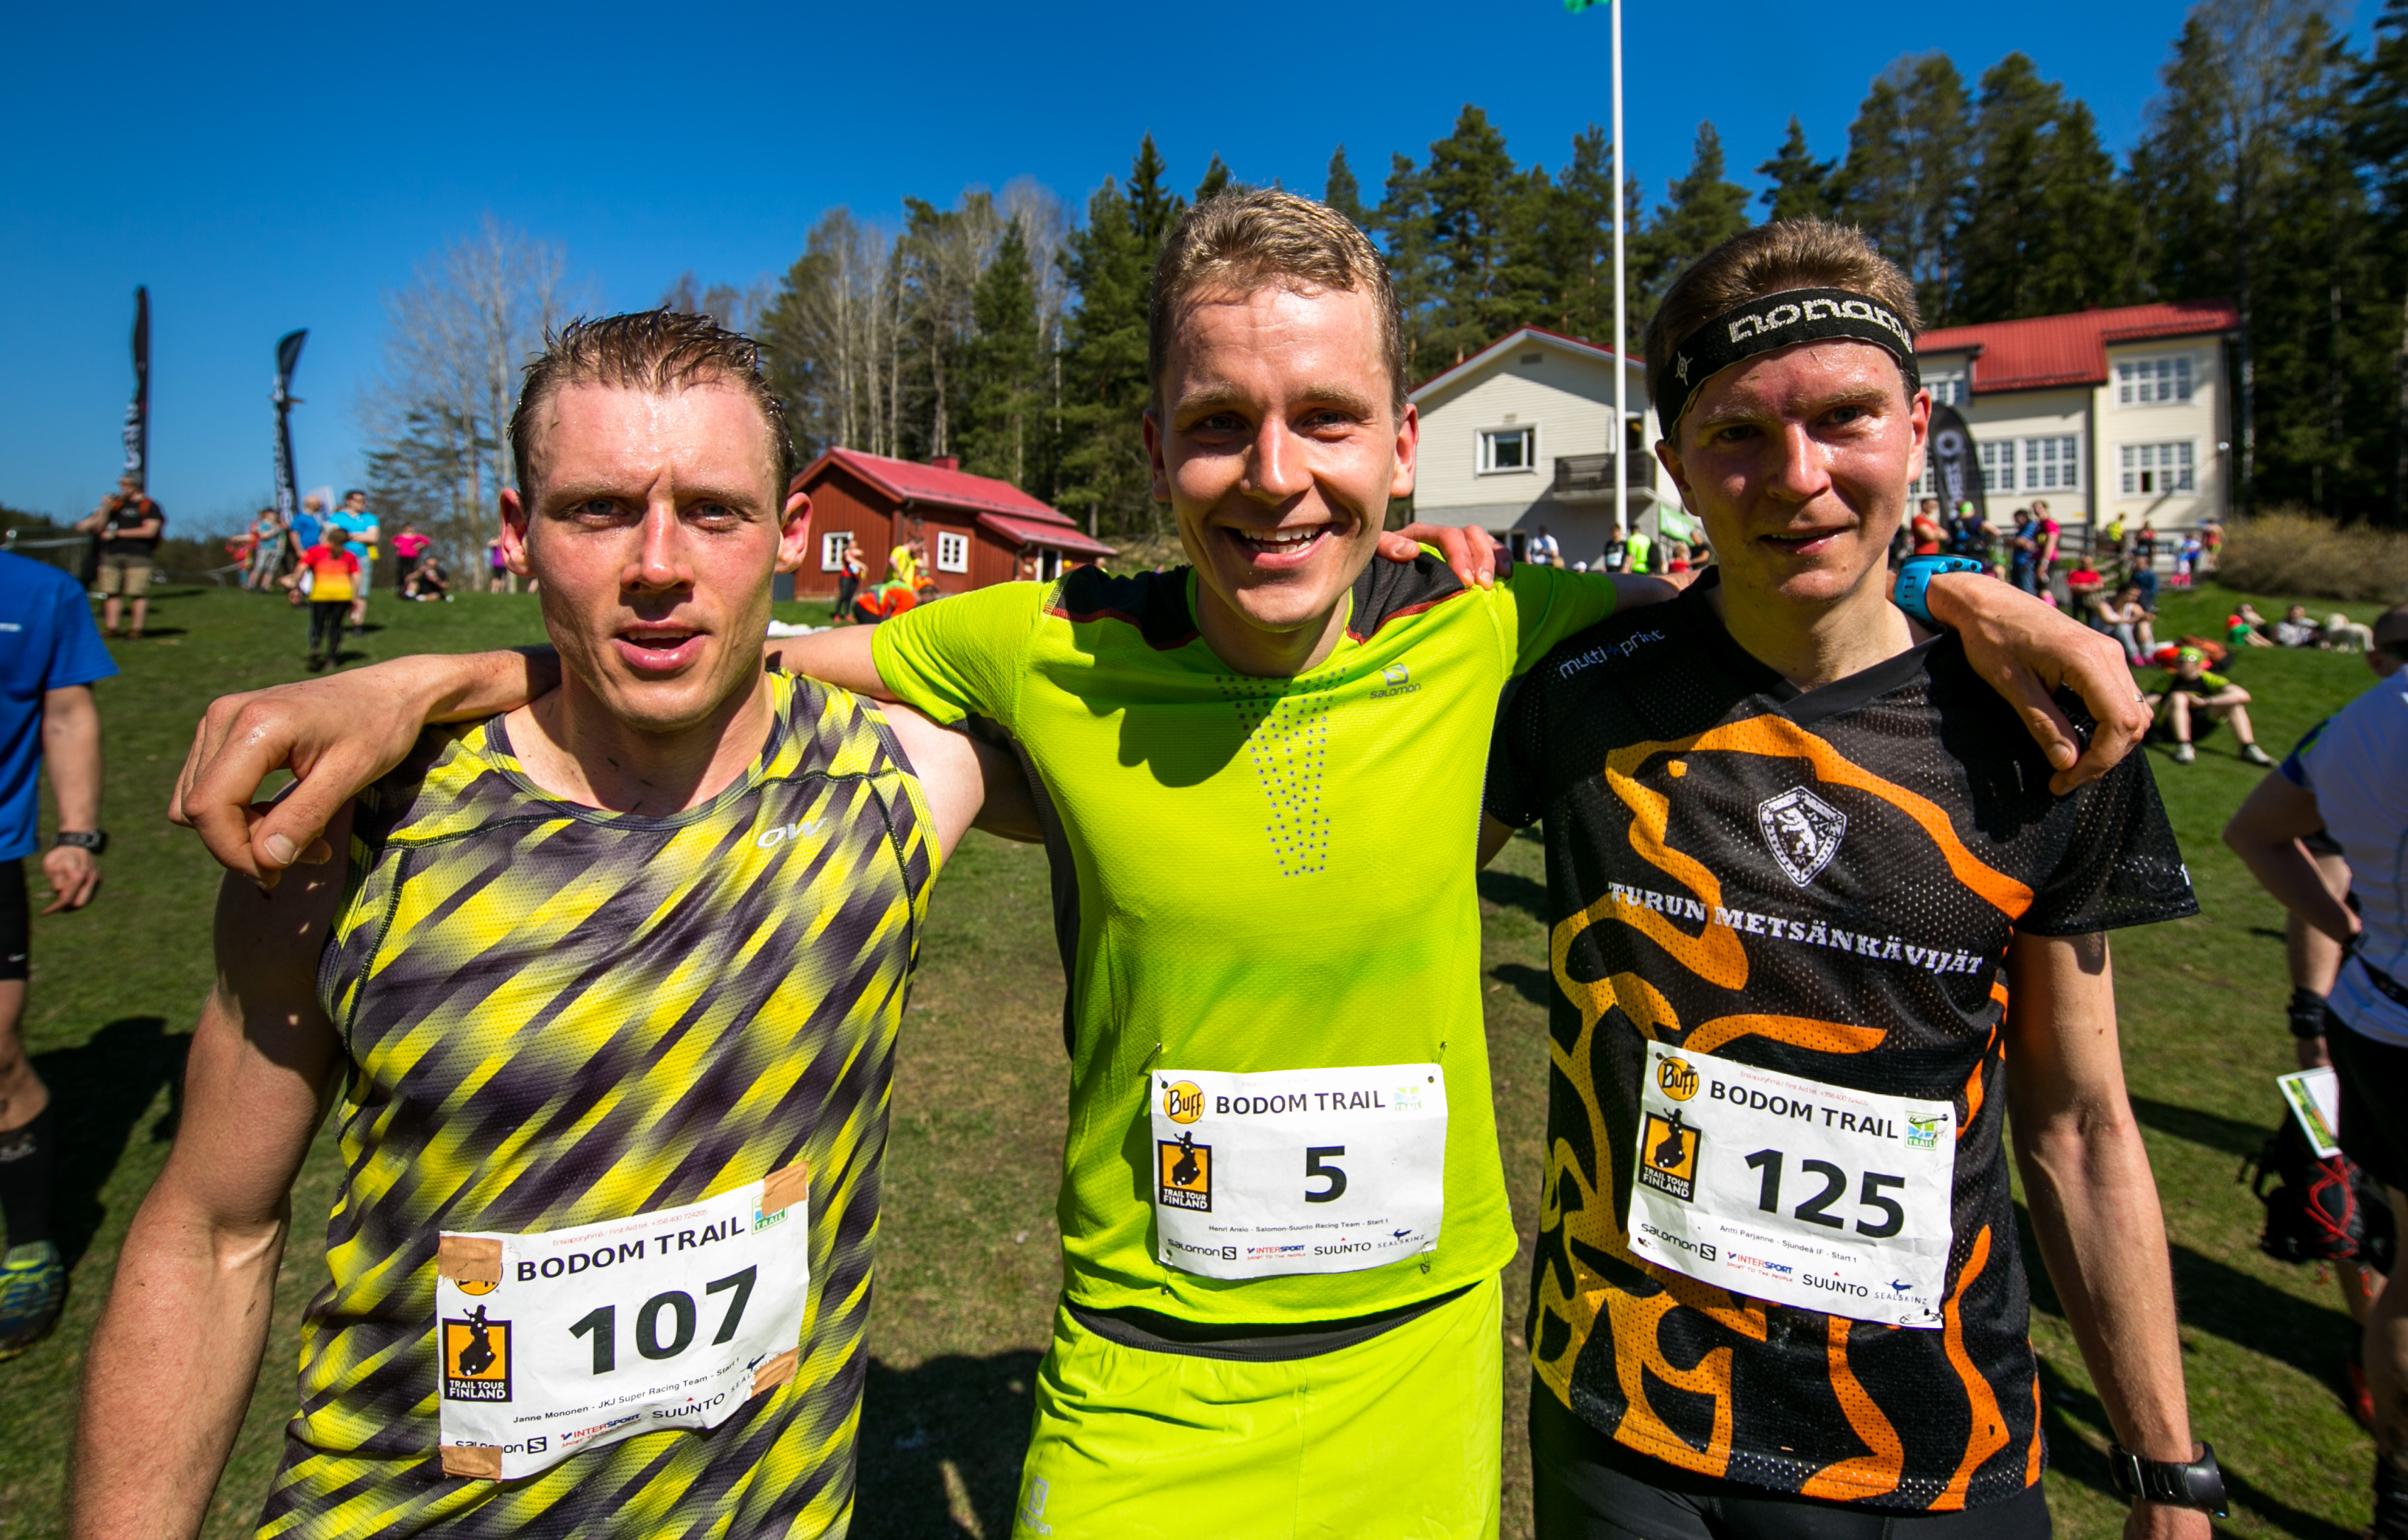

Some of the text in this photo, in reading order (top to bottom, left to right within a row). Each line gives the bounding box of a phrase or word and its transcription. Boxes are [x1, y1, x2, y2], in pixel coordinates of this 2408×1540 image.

[1370, 683, 1421, 699] salomon
[1608, 881, 1983, 975] TURUN METSÄNKÄVIJÄT
[1216, 1090, 1386, 1115] BODOM TRAIL
[1710, 1080, 1899, 1139] BODOM TRAIL
[1908, 1138, 1934, 1148] TRAIL
[1305, 1145, 1347, 1203] 5
[1643, 1173, 1689, 1198] FINLAND
[1644, 1166, 1689, 1189] TRAIL TOUR
[1163, 1195, 1208, 1210] FINLAND
[1164, 1188, 1207, 1201] TRAIL TOUR
[1744, 1149, 1905, 1239] 125
[755, 1213, 784, 1231] TRAIL
[518, 1216, 745, 1282] BODOM TRAIL
[1168, 1239, 1220, 1256] salomon
[1256, 1244, 1305, 1254] INTERSPORT
[1314, 1242, 1371, 1256] SUUNTO
[1377, 1234, 1425, 1249] SEALSKINZ
[1641, 1224, 1698, 1253] salomon
[1720, 1225, 1738, 1234] Antti
[1740, 1229, 1774, 1244] Parjanne
[1782, 1240, 1814, 1254] Sjundeå
[1832, 1251, 1851, 1262] Start
[1737, 1254, 1793, 1274] INTERSPORT
[1802, 1273, 1868, 1298] SUUNTO
[1875, 1292, 1927, 1305] SEALSKINZ
[568, 1263, 757, 1376] 107
[449, 1388, 506, 1400] FINLAND
[450, 1380, 505, 1390] TRAIL TOUR
[513, 1415, 542, 1424] Janne
[545, 1405, 589, 1419] Mononen
[598, 1398, 615, 1409] JKJ
[618, 1390, 645, 1405] Super
[648, 1383, 680, 1397] Racing
[683, 1376, 708, 1387] Team
[717, 1361, 735, 1376] Start
[652, 1393, 725, 1418] SUUNTO
[574, 1413, 642, 1439] INTERSPORT
